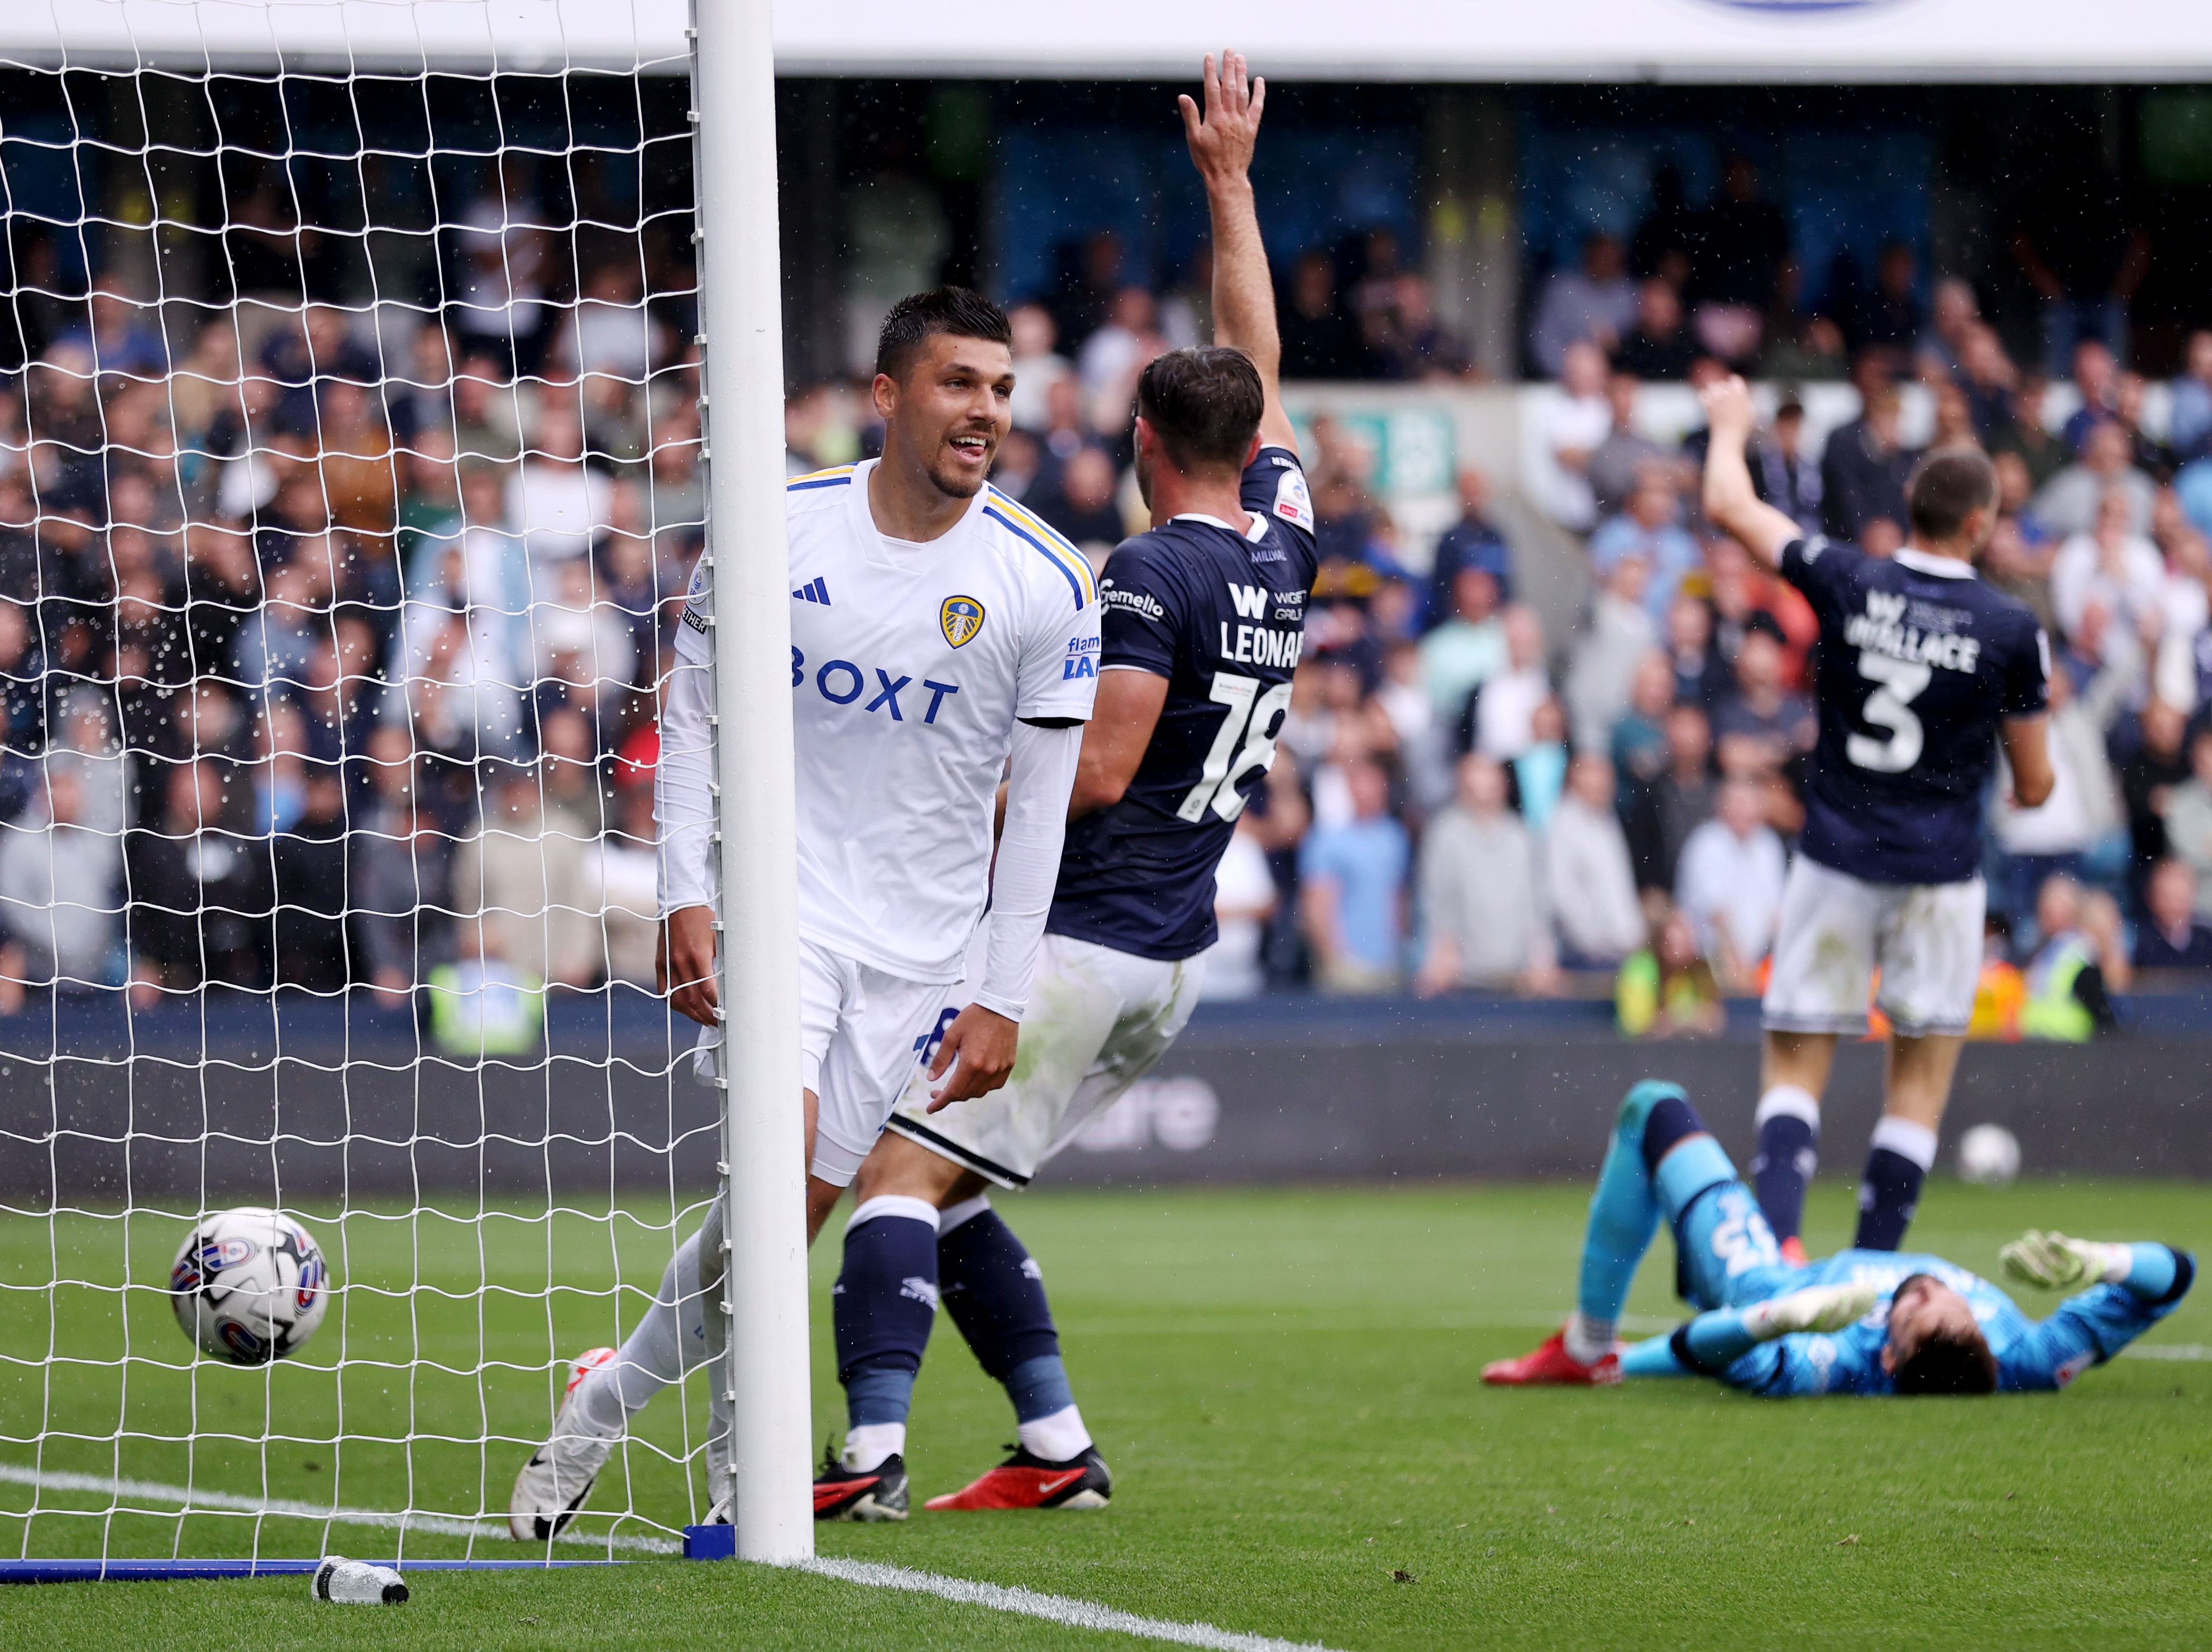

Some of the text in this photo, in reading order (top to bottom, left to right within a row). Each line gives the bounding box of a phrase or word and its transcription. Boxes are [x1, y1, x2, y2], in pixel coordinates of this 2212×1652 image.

[1844, 614, 1981, 673] WALLACE
[1176, 672, 1293, 823] 18
[1846, 651, 1932, 773] 3
